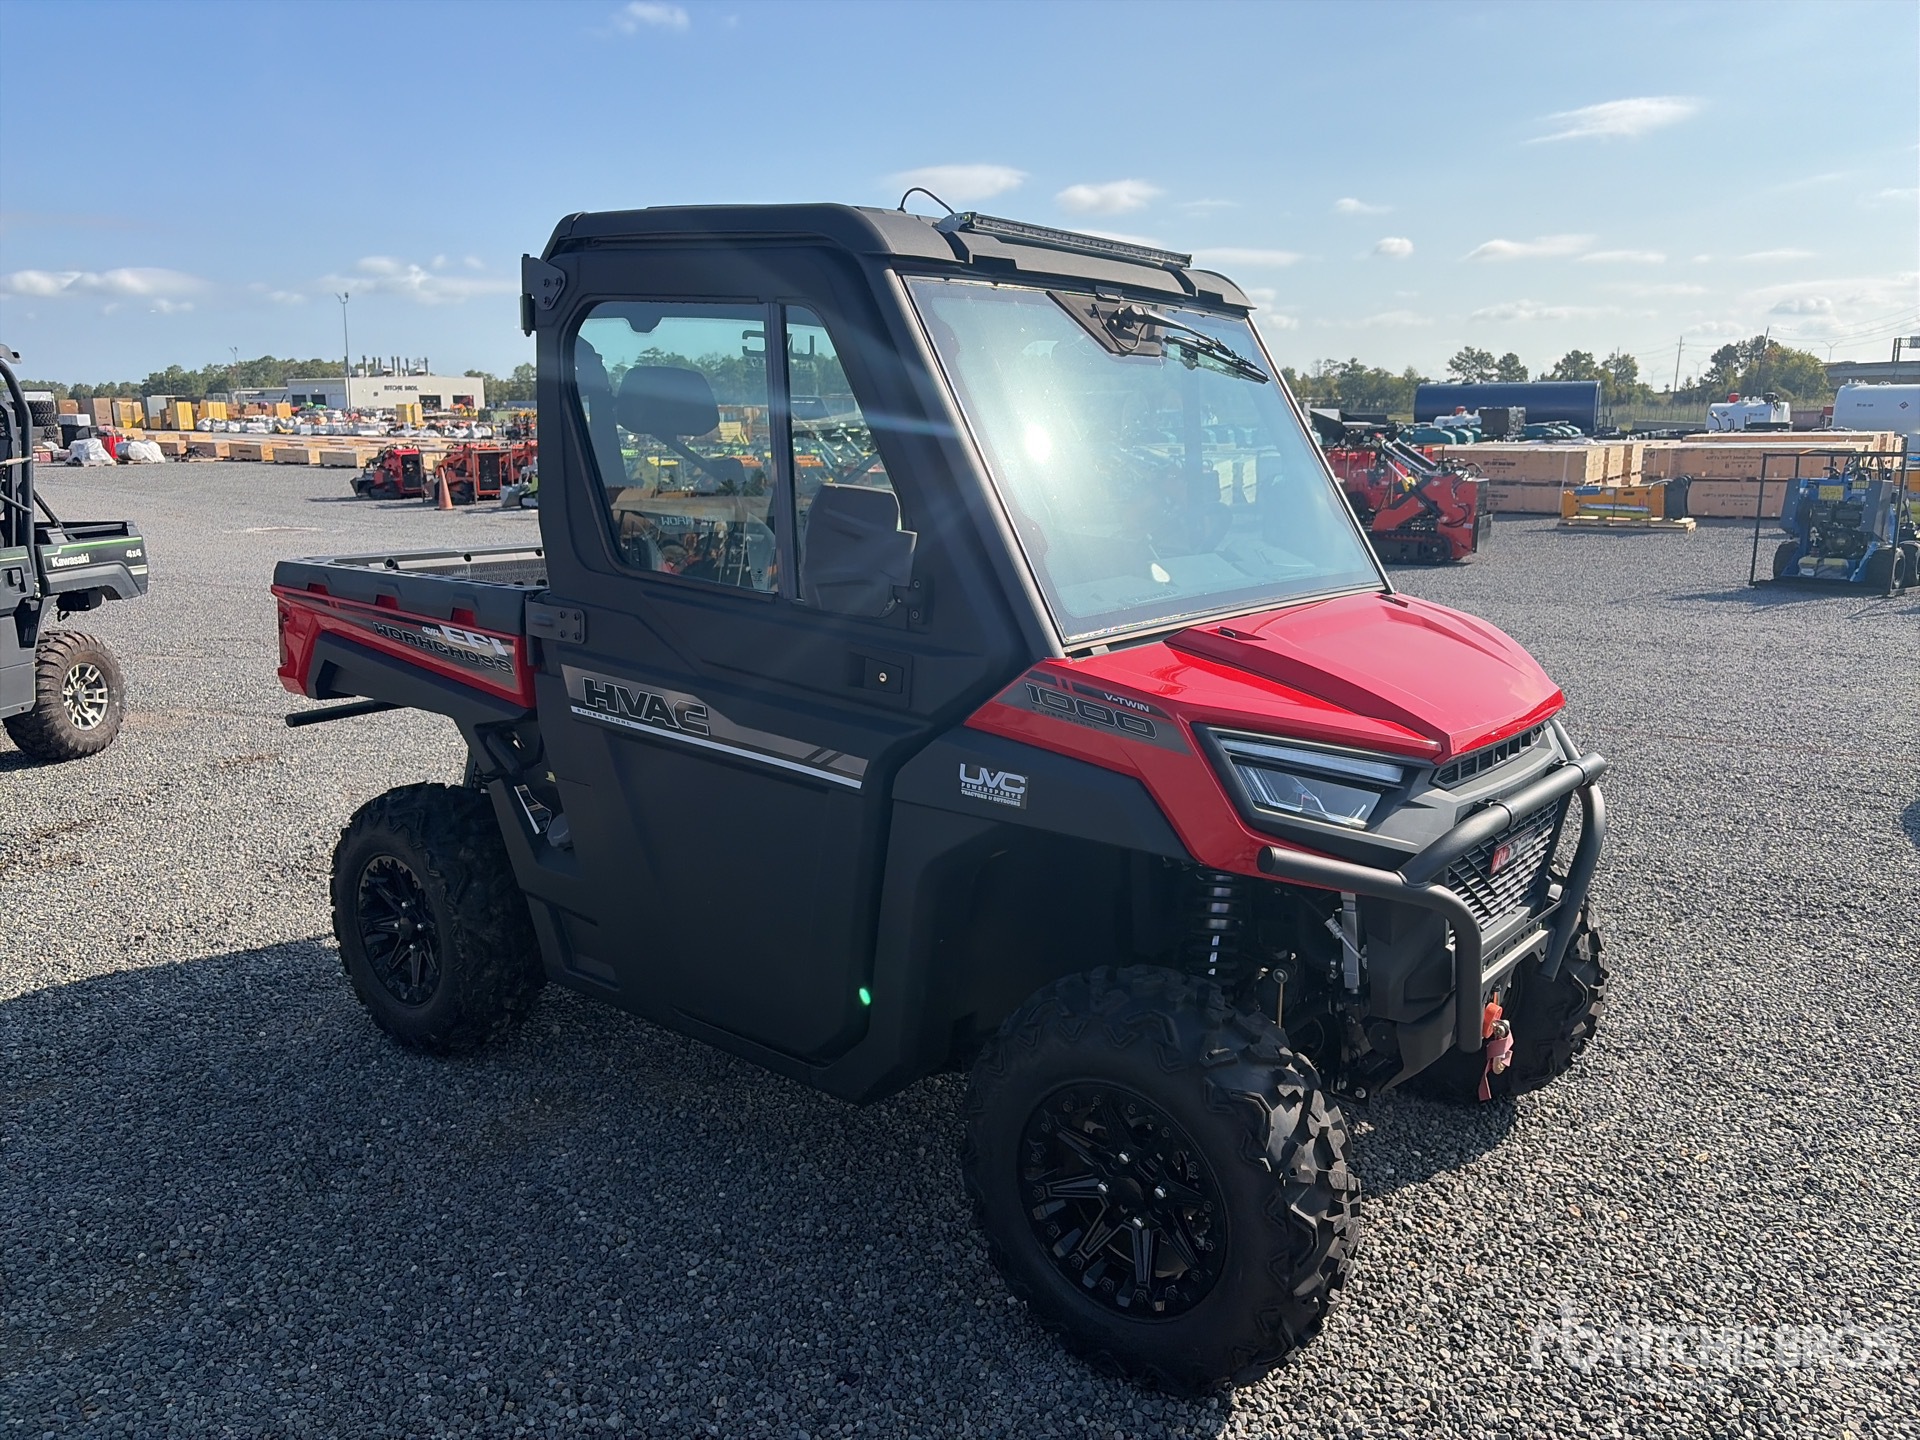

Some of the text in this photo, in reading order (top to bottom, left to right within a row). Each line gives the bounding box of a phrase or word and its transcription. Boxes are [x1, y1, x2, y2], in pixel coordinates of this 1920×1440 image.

[51, 553, 90, 567] Kawasaki
[126, 548, 142, 558] 4x4
[372, 621, 515, 675] WORKCROSS
[439, 624, 509, 657] EFI
[582, 676, 711, 736] HVAC
[1025, 682, 1157, 740] 1000
[1103, 692, 1150, 713] V-TWIN
[959, 762, 1026, 794] UVC
[961, 782, 1022, 800] POWERSPORTS
[960, 789, 988, 800] TRACTORS
[992, 796, 1021, 807] OUTDOORS
